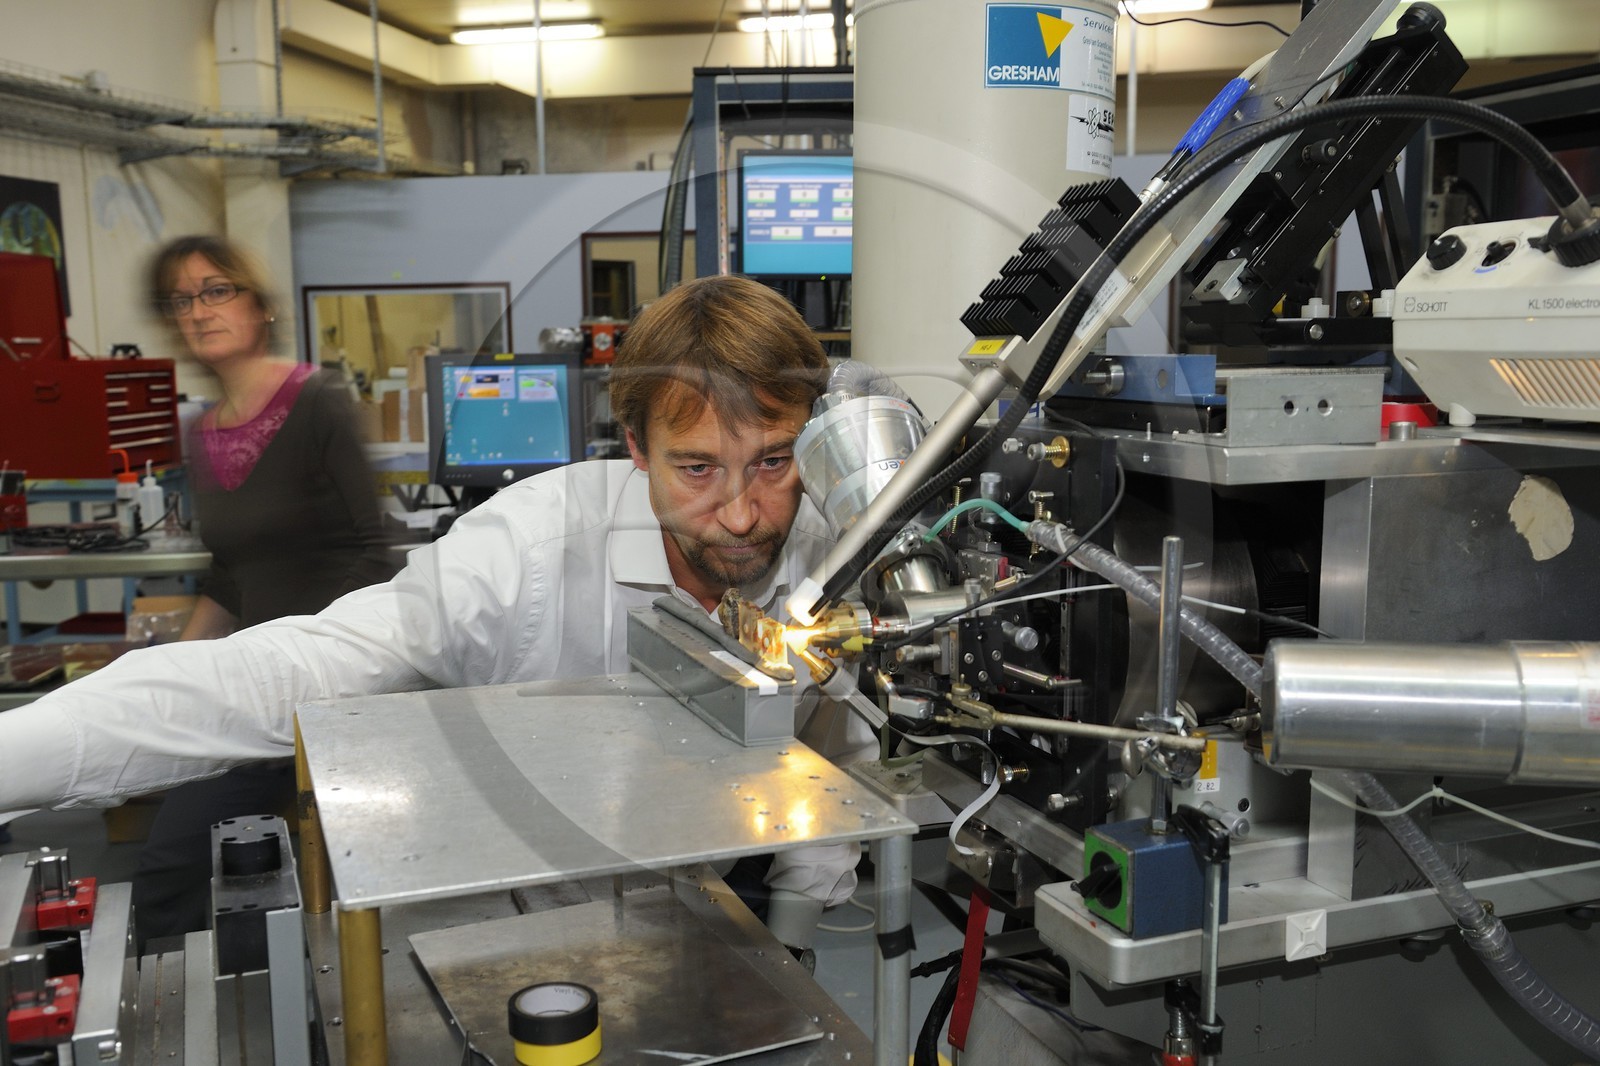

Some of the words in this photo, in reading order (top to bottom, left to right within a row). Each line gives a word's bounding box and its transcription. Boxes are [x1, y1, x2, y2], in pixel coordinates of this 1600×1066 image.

[988, 64, 1060, 82] GRESHAM
[1416, 301, 1449, 313] SCHOTT
[1528, 298, 1541, 310] KL
[1542, 297, 1565, 310] 1500
